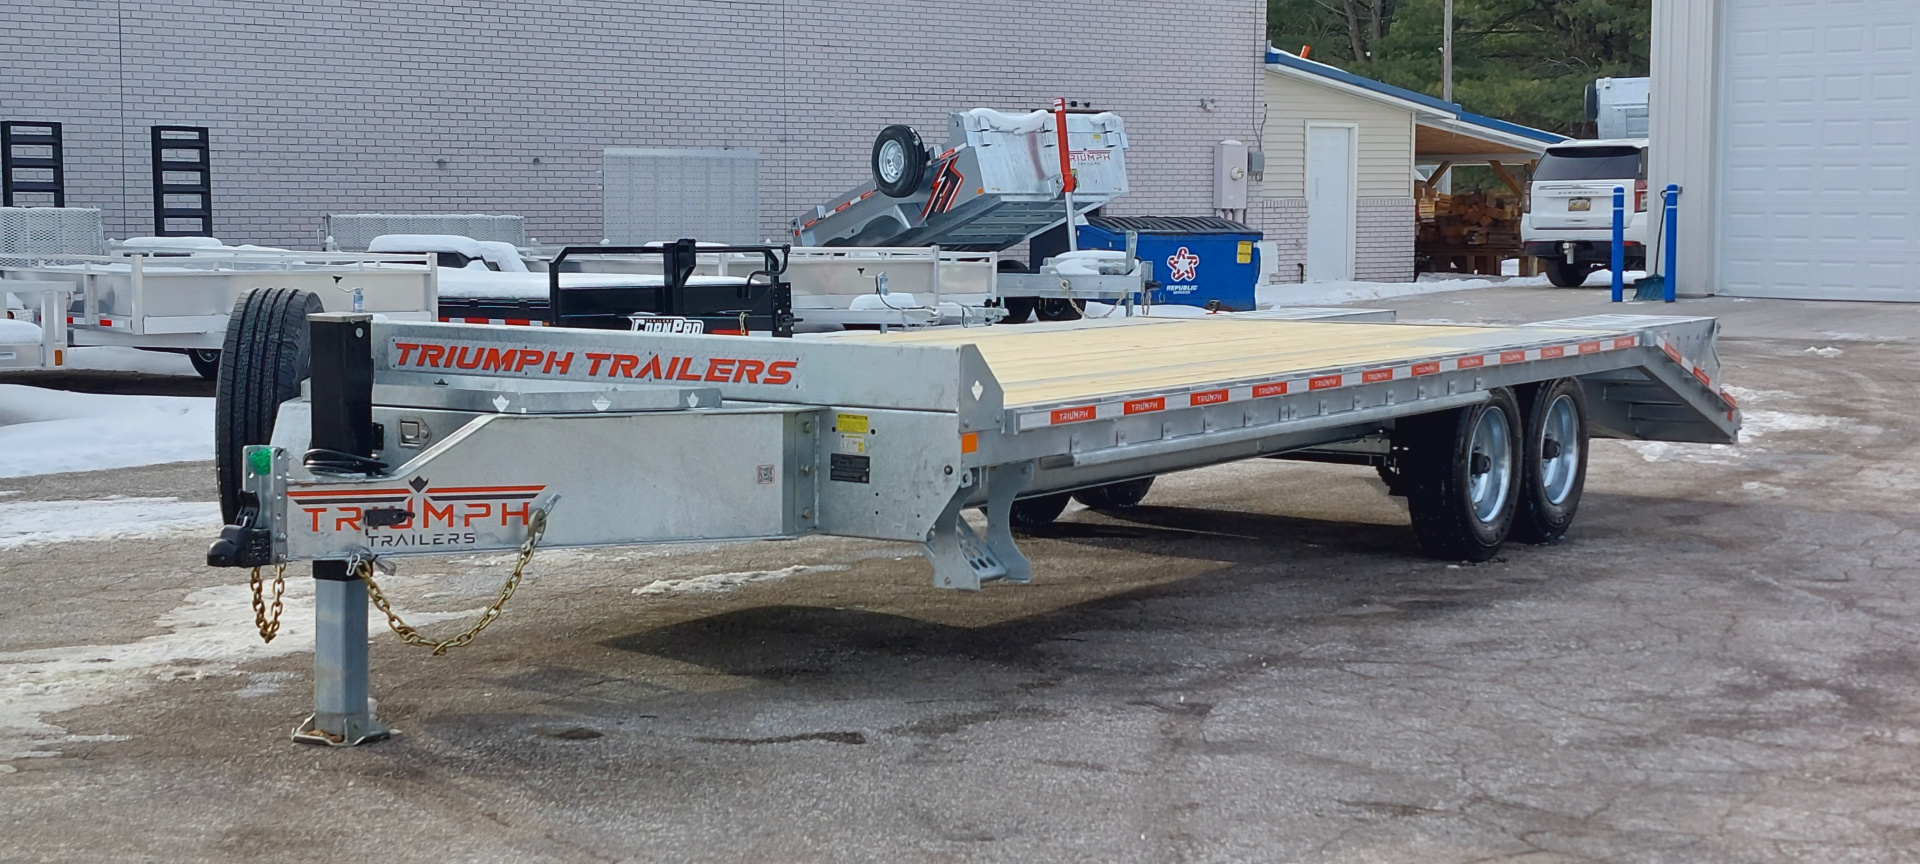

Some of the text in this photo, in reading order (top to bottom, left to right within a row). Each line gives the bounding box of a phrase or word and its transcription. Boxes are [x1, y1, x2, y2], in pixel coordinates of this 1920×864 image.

[1070, 153, 1111, 162] RIUMPH
[395, 342, 798, 385] TRIUMPH TRAILERS
[1197, 393, 1222, 403] TRIUMPH
[1131, 401, 1158, 412] TRIUMPH
[1059, 410, 1089, 421] TRIUMPH
[368, 532, 476, 548] TRAILERS
